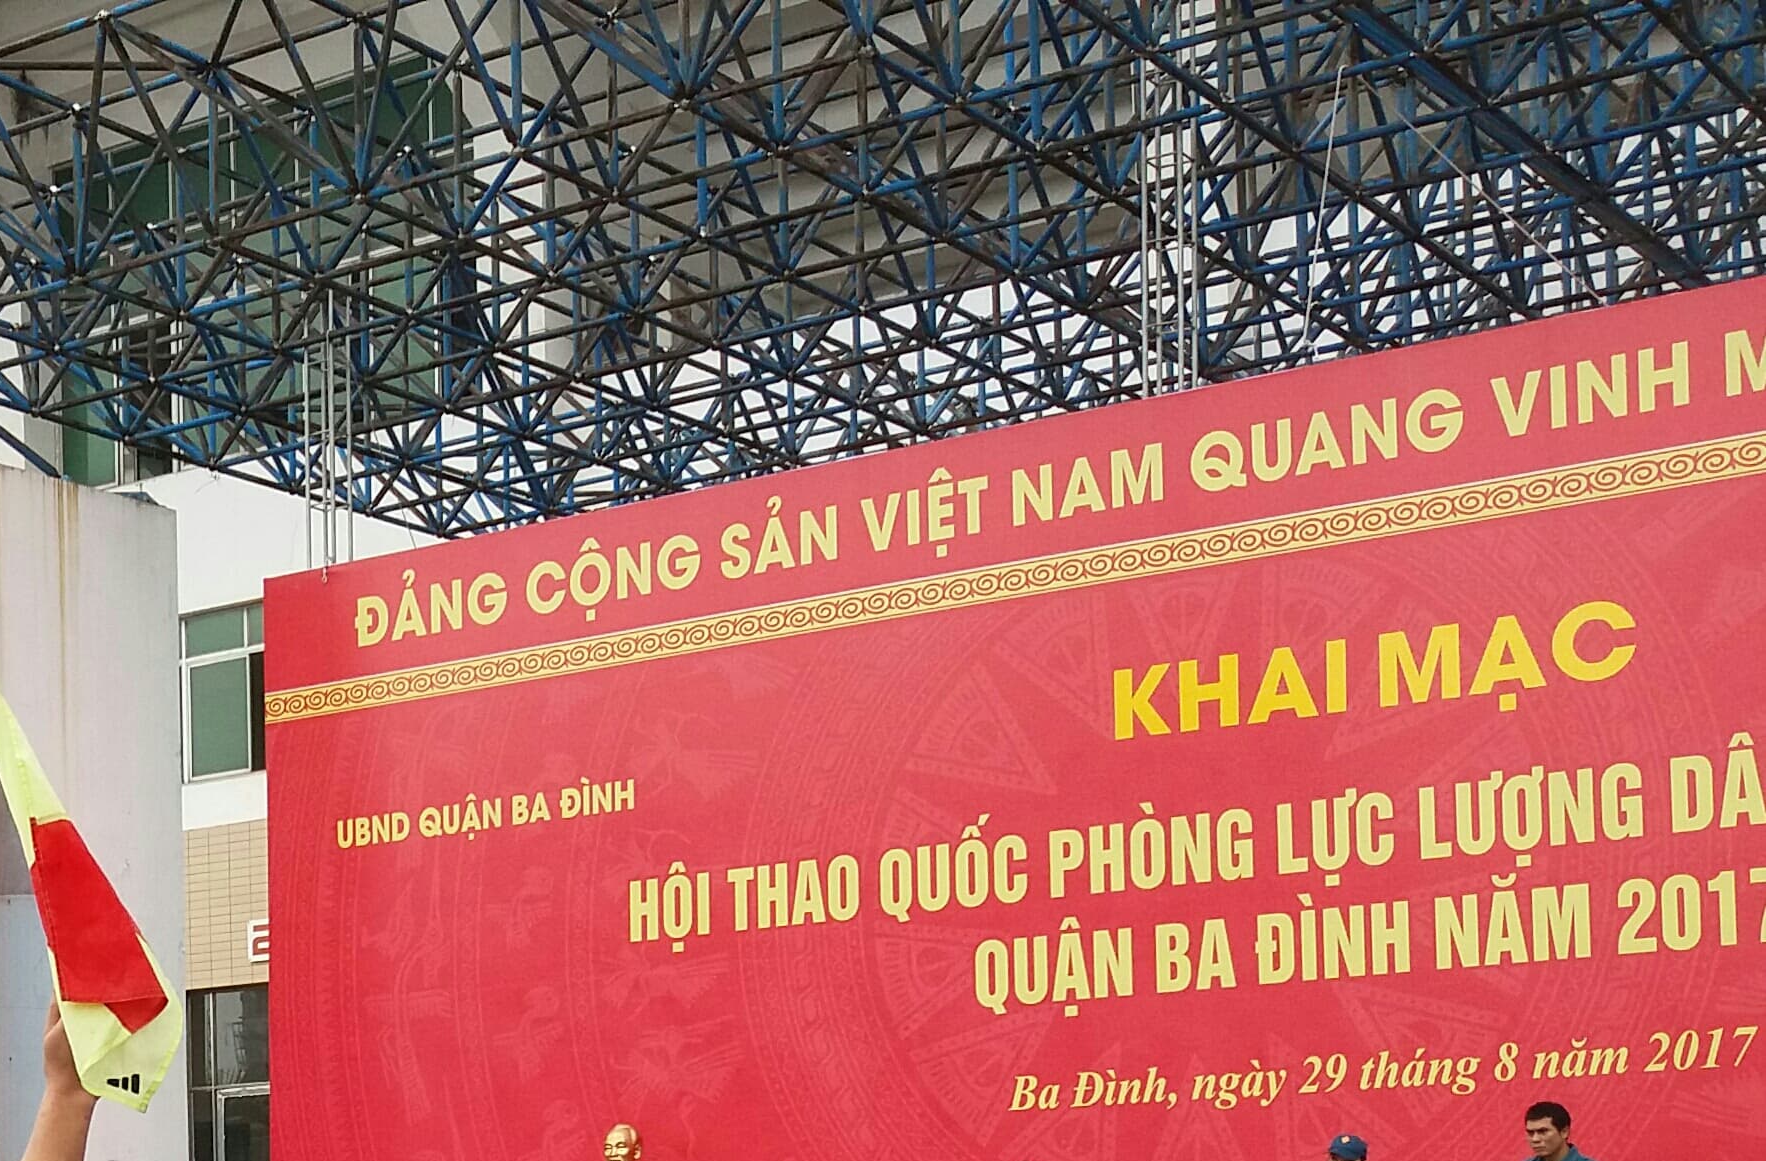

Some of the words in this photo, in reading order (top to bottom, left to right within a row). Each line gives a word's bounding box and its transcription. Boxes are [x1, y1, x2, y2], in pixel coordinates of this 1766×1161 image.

[354, 568, 508, 648] ĐẢNG
[525, 537, 701, 622] CỘNG
[720, 495, 838, 579] SẢN
[860, 466, 989, 558] VIỆT
[1011, 442, 1164, 527] NAM
[1190, 388, 1464, 492] QUANG
[1489, 340, 1690, 437] VINH
[1113, 638, 1347, 741] KHAI
[1378, 600, 1637, 712] MẠC
[337, 811, 411, 849] UBND
[418, 793, 502, 840] QUẬN
[511, 791, 551, 826] BA
[559, 776, 635, 819] ĐÌNH
[629, 861, 710, 953] HỘI
[727, 854, 860, 932] THAO
[879, 813, 1028, 923] QUỐC
[1048, 801, 1254, 899] PHÒNG
[1276, 787, 1395, 887] LỰC
[1418, 762, 1644, 868] LƯỢNG
[974, 916, 1134, 1018] QUẬN
[1155, 912, 1237, 994] BA
[1254, 893, 1411, 985] ĐÌNH
[1434, 872, 1592, 970] NĂM
[1008, 1075, 1060, 1111] Ba
[1070, 1066, 1177, 1109] Đình,
[1191, 1058, 1287, 1110] ngày
[1298, 1053, 1348, 1094] 29
[1359, 1046, 1481, 1095] tháng
[1494, 1042, 1519, 1082] 8
[1532, 1037, 1629, 1079] năm
[1644, 1026, 1758, 1072] 2017
